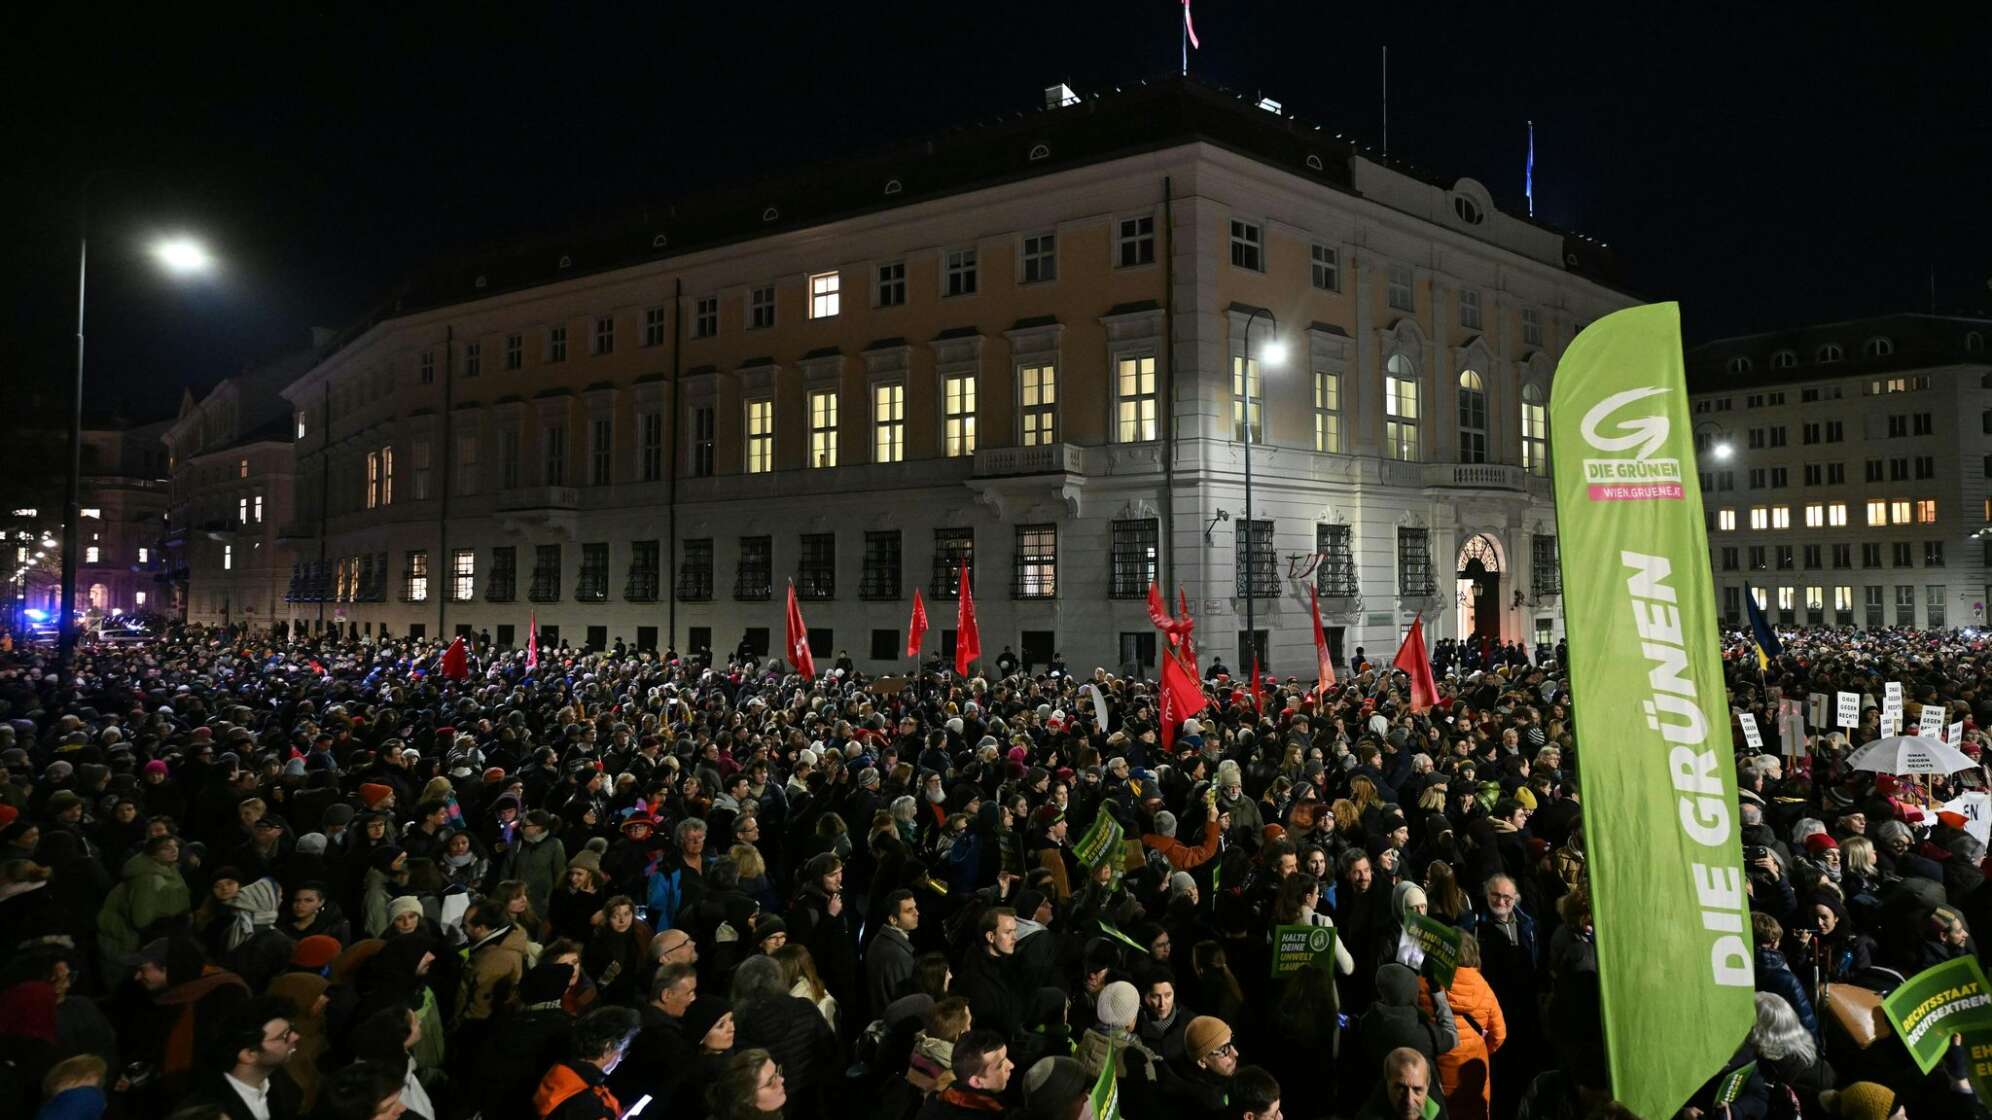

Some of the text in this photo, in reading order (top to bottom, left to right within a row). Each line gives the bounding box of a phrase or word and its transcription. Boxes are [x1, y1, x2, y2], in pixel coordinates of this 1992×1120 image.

[1588, 461, 1680, 478] DIE GRÜNEN
[1620, 550, 1755, 987] DIE GRÜNEN
[1281, 933, 1307, 942] HALTE
[1280, 943, 1306, 952] DEINE
[1902, 982, 1978, 1032] RECHTSSTAAT
